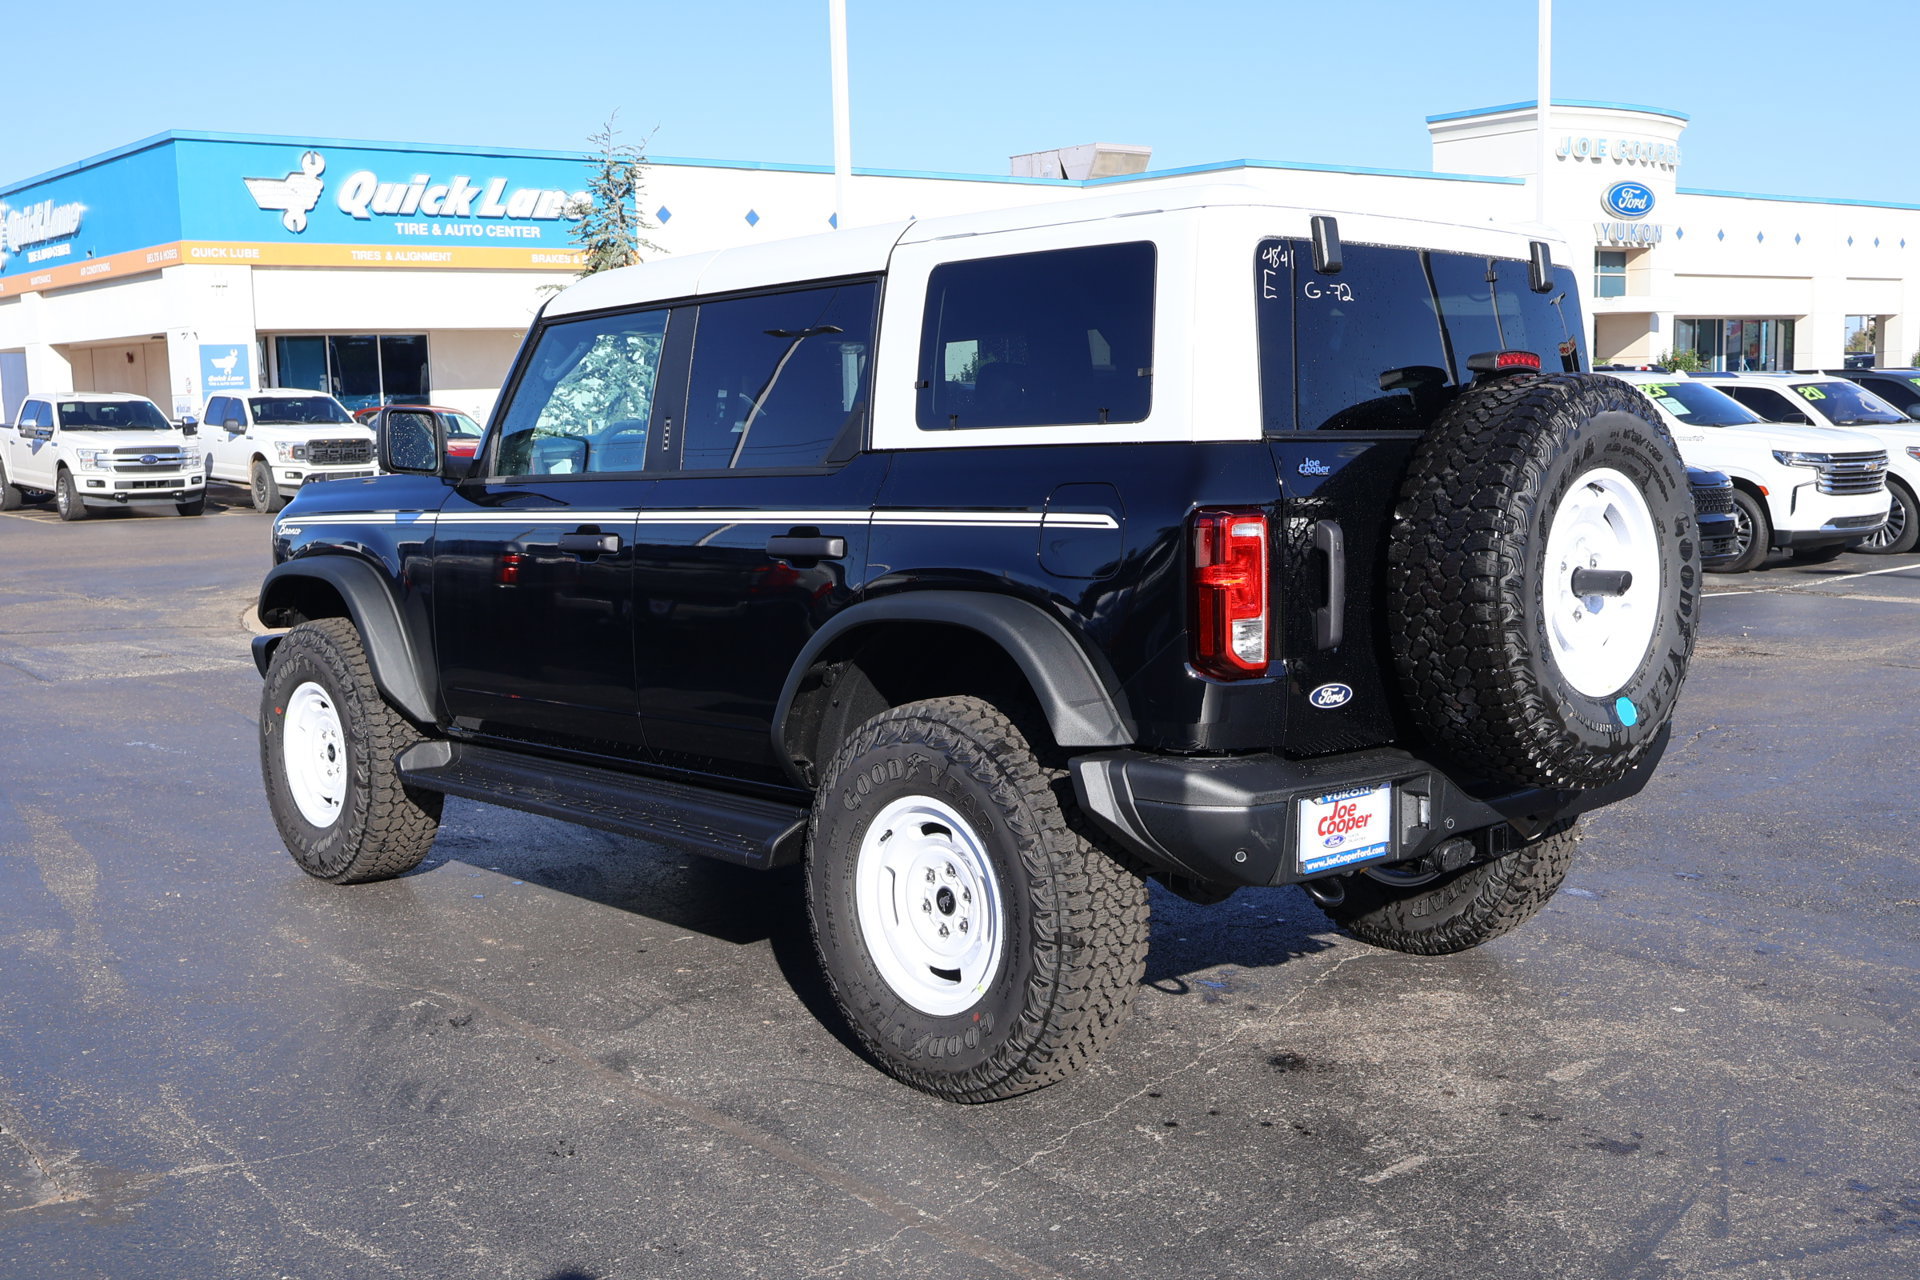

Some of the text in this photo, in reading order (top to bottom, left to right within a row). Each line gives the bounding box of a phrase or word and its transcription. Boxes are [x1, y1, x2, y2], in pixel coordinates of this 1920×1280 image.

[1559, 136, 1682, 166] JOE COOPER
[337, 170, 594, 222] Quick Lane
[1617, 187, 1647, 210] Ford
[7, 199, 82, 252] Quick Lane
[394, 222, 541, 239] TIRE & AUTO CENTER
[1597, 222, 1662, 244] YUKON
[146, 252, 160, 264] BELTS
[163, 248, 178, 261] HOSES
[190, 247, 261, 259] QUICK LUBE
[351, 250, 452, 262] TIRES & ALIGNMENT
[531, 253, 571, 264] BRAKES
[573, 255, 581, 265] &
[1261, 244, 1295, 269] 4841
[1304, 281, 1355, 301] G-72
[1796, 385, 1826, 401] 20
[1298, 463, 1331, 474] Cooper
[1304, 457, 1320, 467] Joe
[277, 523, 301, 536] Bronco
[1317, 686, 1346, 705] Ford
[842, 752, 996, 838] GOODYEAR
[1325, 786, 1369, 802] YUKON
[1329, 801, 1357, 821] Joe
[1317, 813, 1373, 837] Cooper
